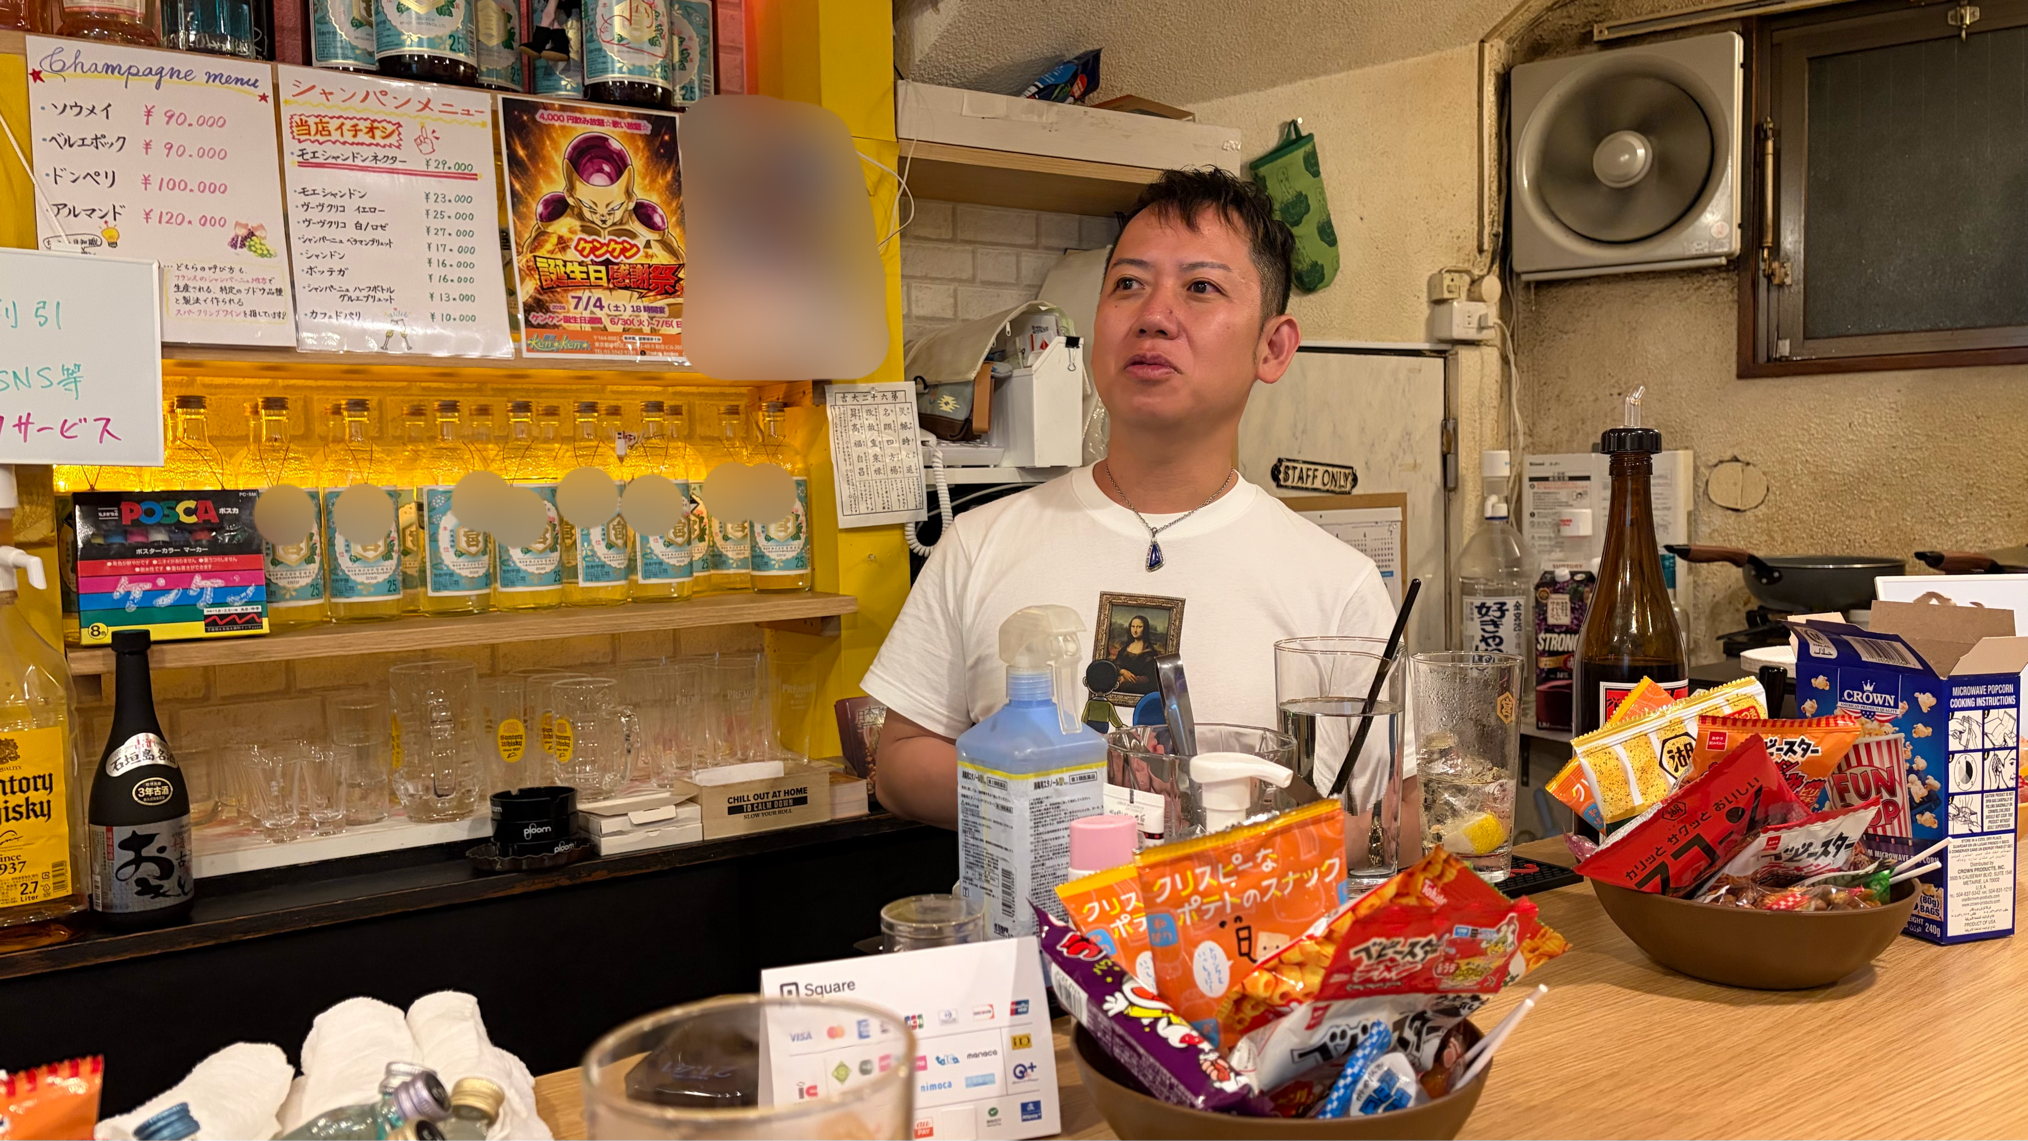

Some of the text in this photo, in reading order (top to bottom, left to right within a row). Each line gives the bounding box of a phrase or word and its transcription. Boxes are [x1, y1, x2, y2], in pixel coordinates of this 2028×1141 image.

[40, 47, 196, 90] Champagne
[205, 69, 259, 89] menu
[292, 79, 486, 117] シャンパンメニュー
[51, 102, 113, 120] ソウメイ
[295, 118, 397, 140] 当店イチオシ
[49, 132, 127, 153] ベルエポック
[297, 148, 408, 165] モエシャンドンネクター
[53, 167, 116, 189] ドンペリ
[298, 187, 368, 200] モエシャンドン
[51, 203, 126, 222] アルマンド
[577, 239, 638, 257] ケンケン
[571, 296, 605, 312] 7/4
[0, 412, 122, 444] サービス
[1282, 465, 1351, 489] STAFF ONLY
[121, 500, 220, 526] POSCA
[219, 507, 239, 515] ポスカ
[135, 547, 180, 555] ポスターカラー
[112, 573, 257, 612] ケンケン
[1843, 689, 1895, 707] CROWN
[1952, 684, 2013, 696] MICROWAVE POPCORN
[1950, 695, 2016, 708] COOKING INSTRUCTIONS
[138, 786, 170, 798] 3年古酒
[1831, 765, 1898, 801] FUN
[727, 787, 808, 804] CHILL OUT AT HOME
[743, 804, 752, 812] TO
[753, 801, 772, 811] CALM
[524, 823, 551, 840] ploom
[1625, 777, 1760, 881] カリッと サクッと おいしい
[1153, 848, 1278, 903] クリスピーな
[20, 881, 39, 896] 2.7
[1177, 857, 1340, 926] ポテトのスナック
[20, 895, 39, 903] Liter
[1920, 905, 1940, 917] BAGS
[1910, 916, 1941, 937] EIGHT 240g
[804, 981, 856, 998] Square
[789, 1031, 813, 1043] VISA
[921, 1081, 953, 1092] nimoca
